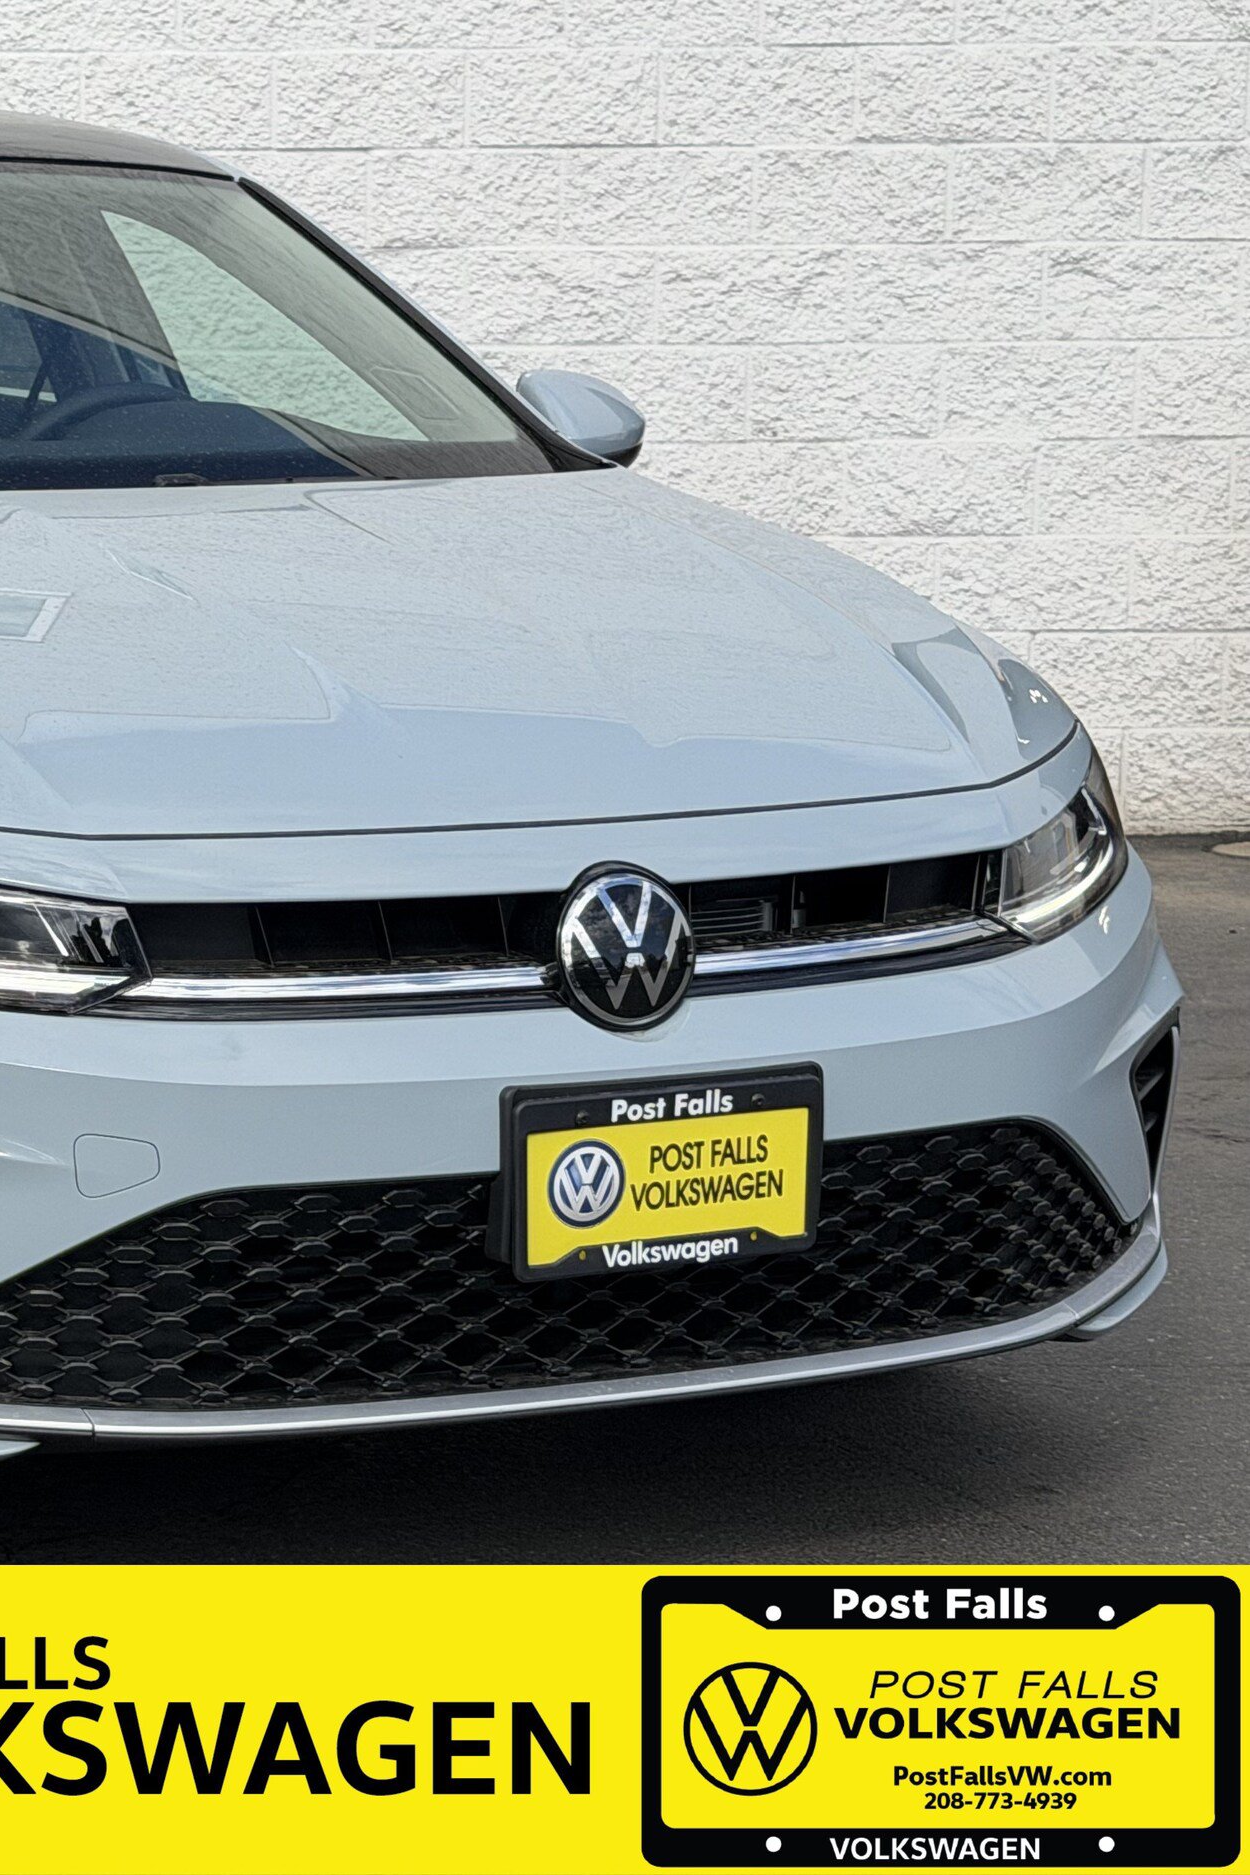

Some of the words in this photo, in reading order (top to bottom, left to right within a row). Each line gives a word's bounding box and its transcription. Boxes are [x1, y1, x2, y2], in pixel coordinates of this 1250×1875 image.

[611, 1097, 666, 1123] Post
[674, 1088, 734, 1116] Falls
[650, 1140, 705, 1174] POST
[711, 1134, 768, 1168] FALLS
[630, 1168, 784, 1212] VOLKSWAGEN
[602, 1236, 738, 1268] Volkswagen
